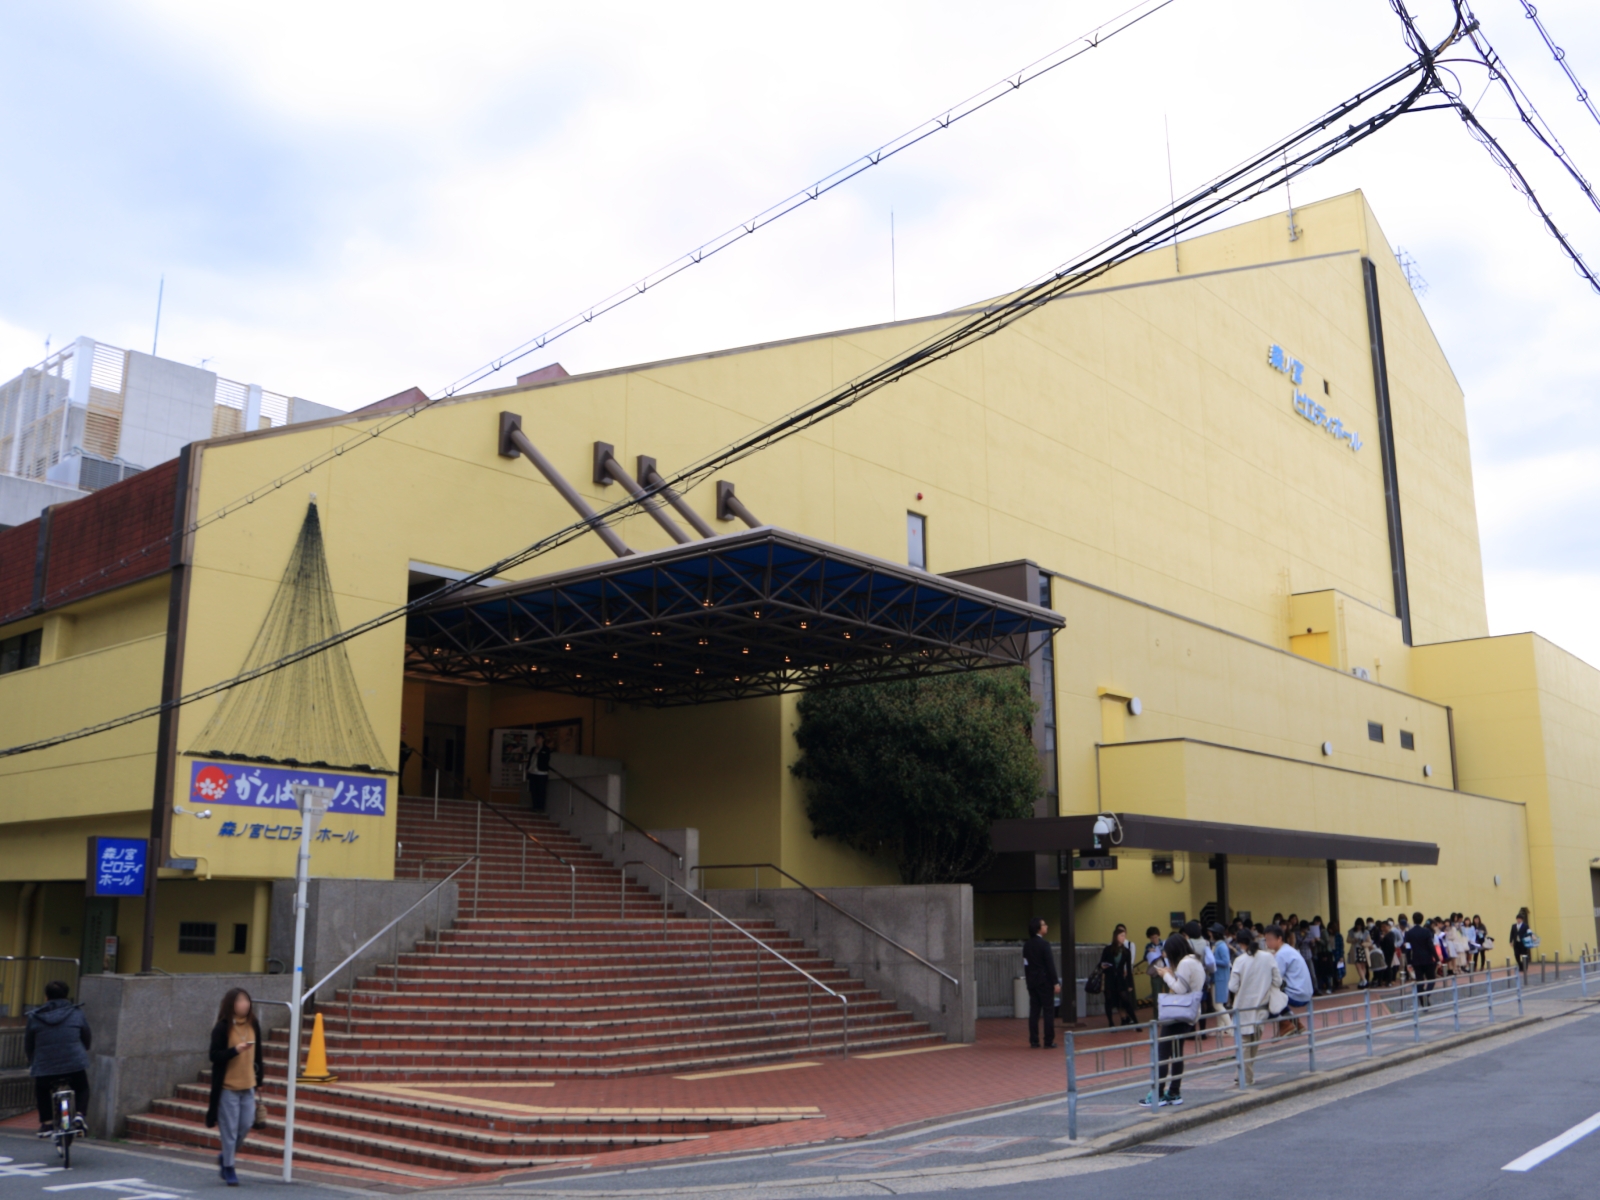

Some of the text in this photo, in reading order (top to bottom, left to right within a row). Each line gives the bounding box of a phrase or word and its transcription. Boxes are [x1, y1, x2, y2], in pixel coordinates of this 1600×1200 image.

[1268, 344, 1304, 385] 森ノ宮
[235, 768, 385, 812] がんば！大阪
[217, 821, 360, 844] 森ノ宮ピロテホール
[101, 847, 138, 860] 森ノ宮
[101, 861, 143, 874] ピロティ
[98, 873, 135, 886] ホール
